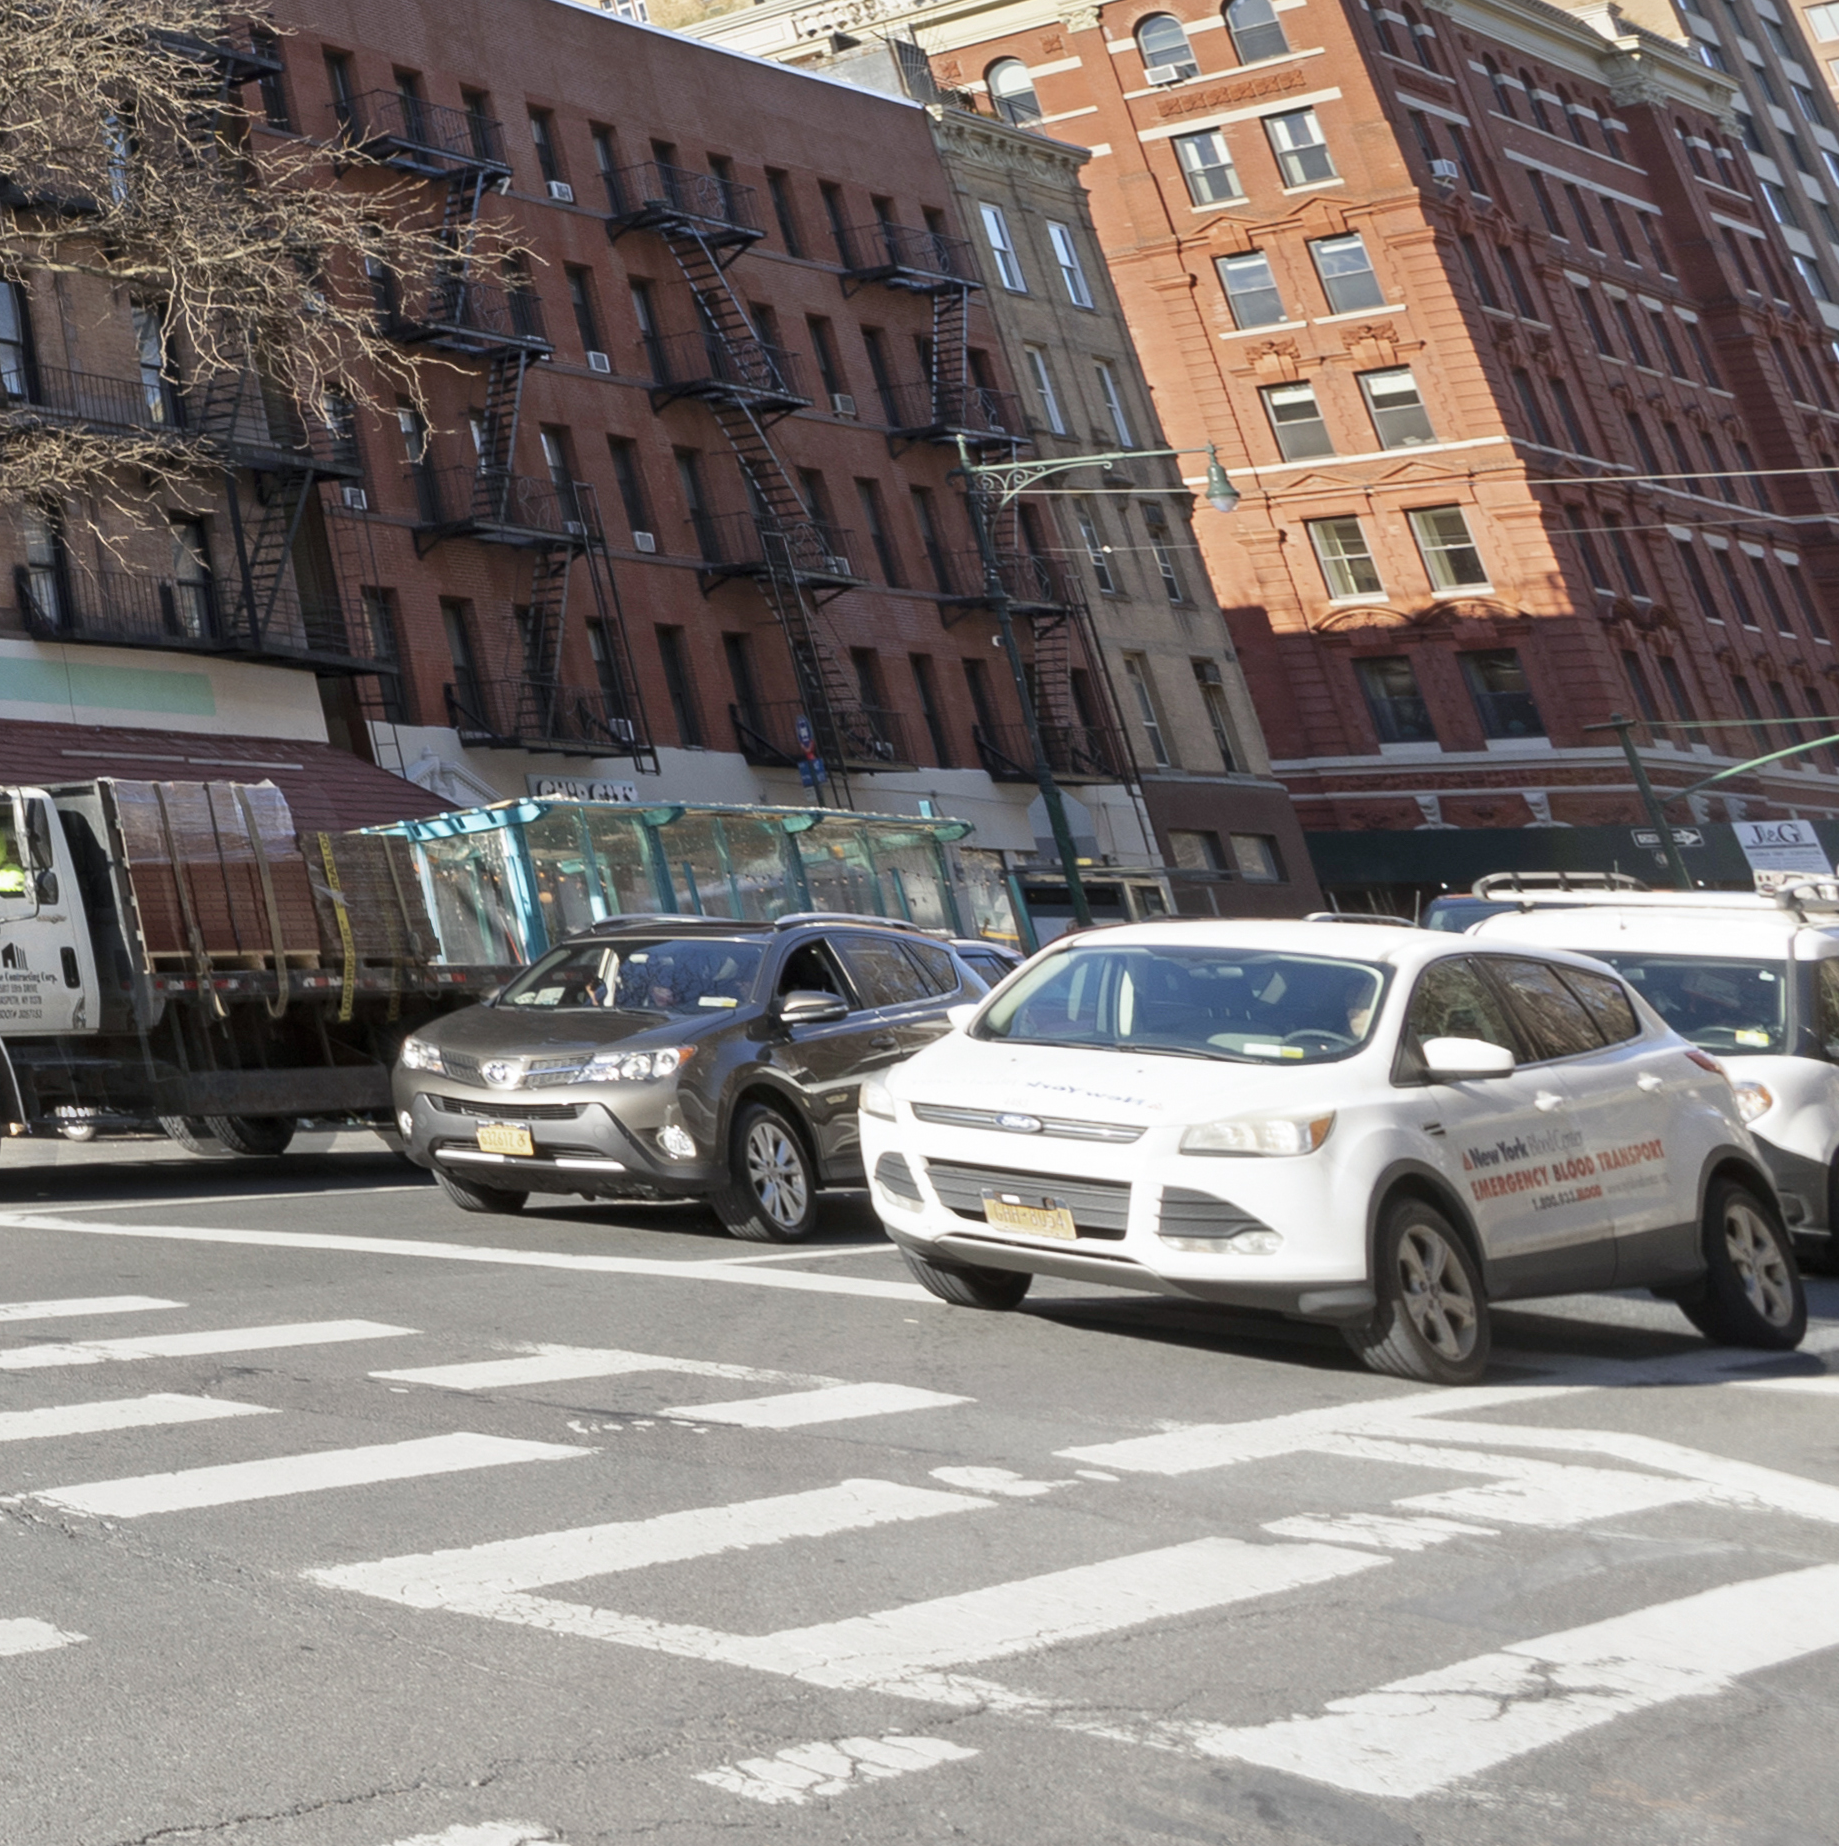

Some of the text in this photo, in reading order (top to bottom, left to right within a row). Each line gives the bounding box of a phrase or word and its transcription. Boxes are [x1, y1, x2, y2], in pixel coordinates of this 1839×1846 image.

[1469, 1148, 1499, 1169] New
[1497, 1137, 1529, 1163] York
[1471, 1139, 1666, 1201] EMERGENCY BLOOD TRANSPORT
